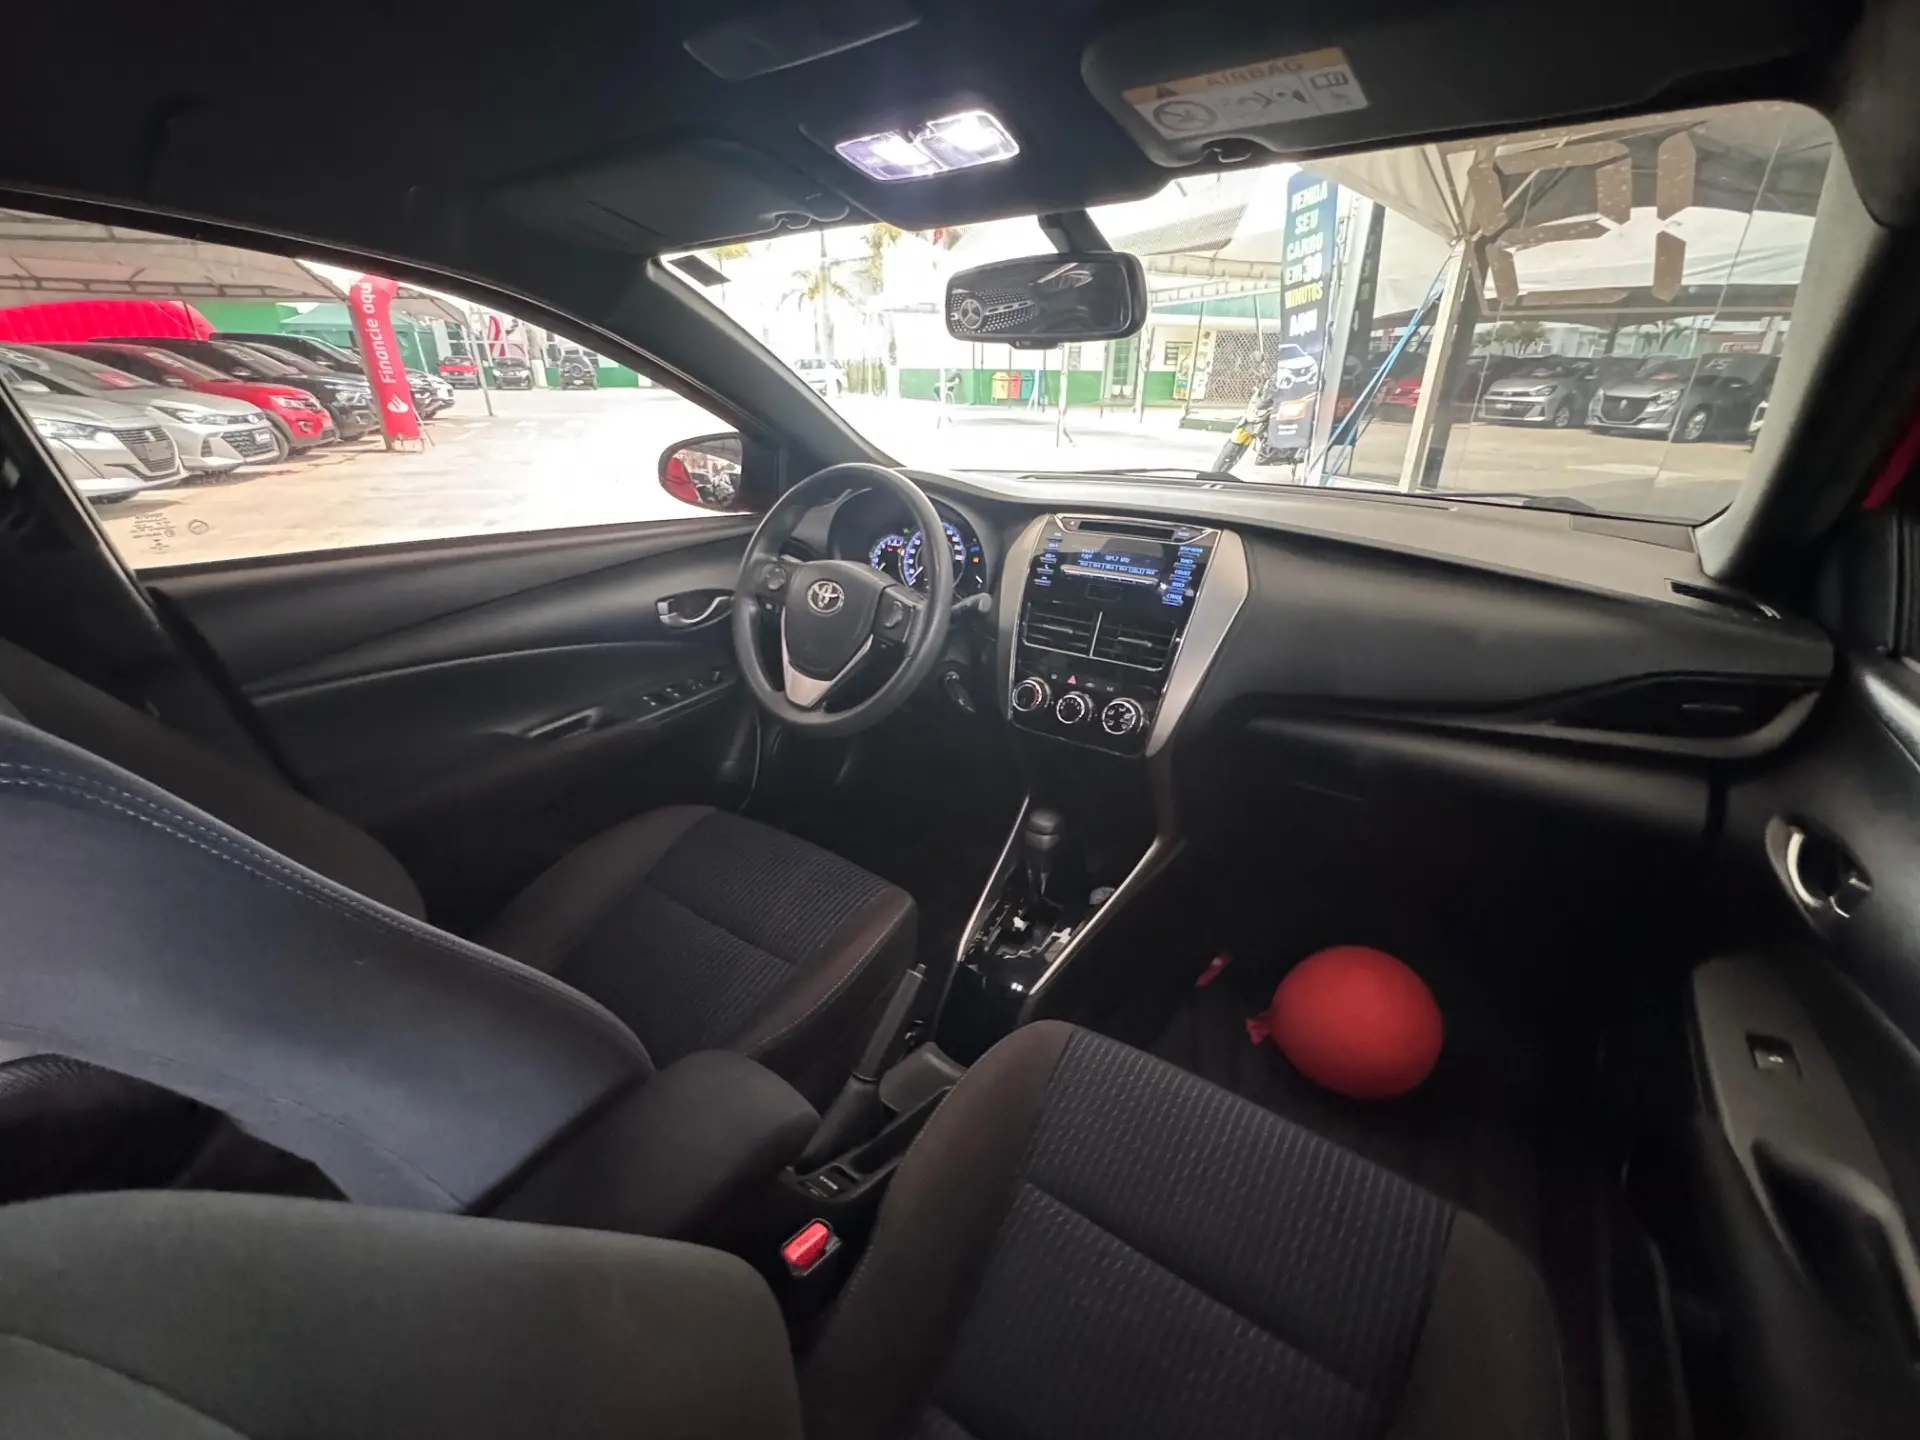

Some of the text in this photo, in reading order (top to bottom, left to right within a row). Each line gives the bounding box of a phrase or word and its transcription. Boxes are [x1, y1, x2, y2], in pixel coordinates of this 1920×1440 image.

[1205, 57, 1304, 88] AIRBAG
[1294, 208, 1319, 235] SEU
[364, 318, 397, 384] Financie
